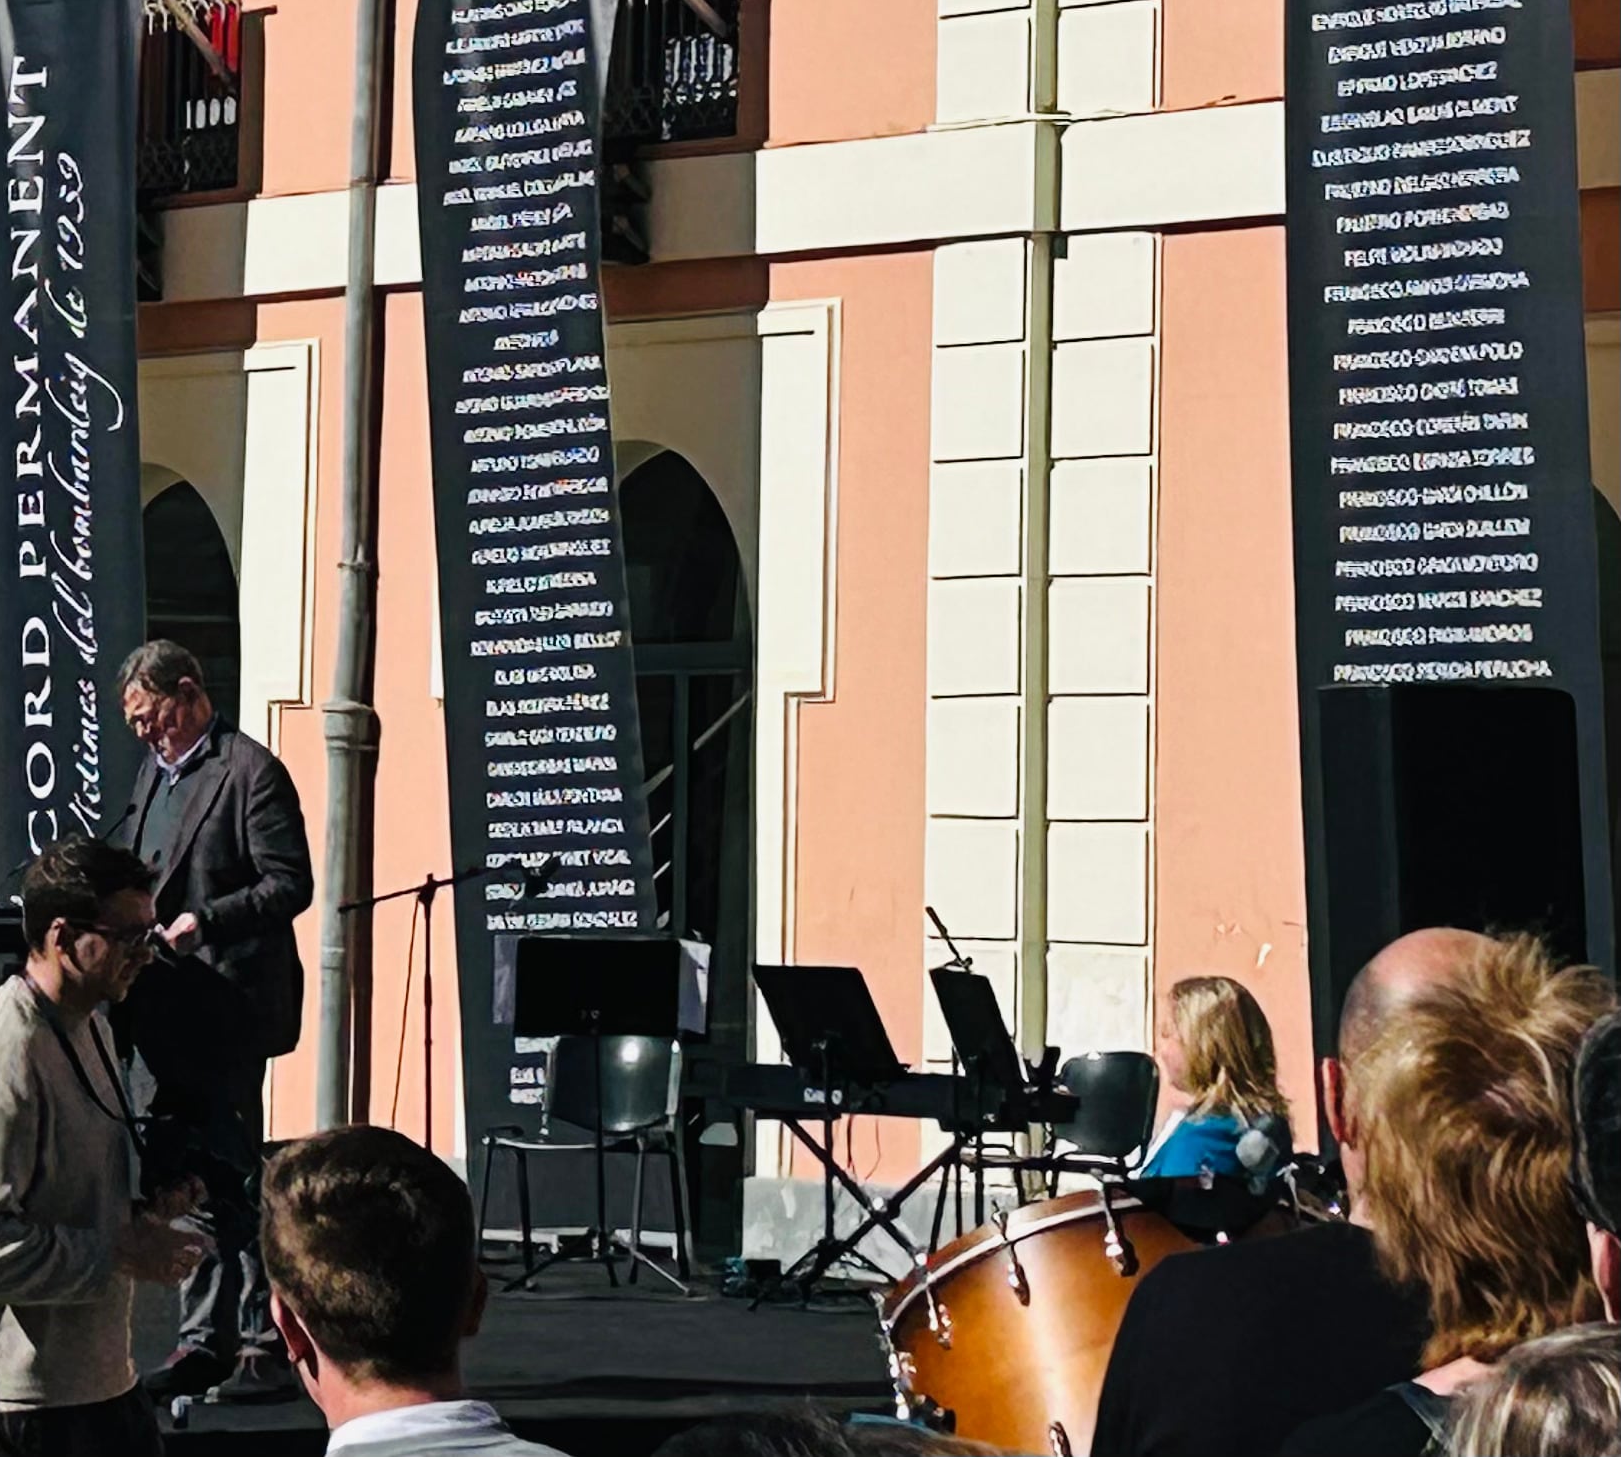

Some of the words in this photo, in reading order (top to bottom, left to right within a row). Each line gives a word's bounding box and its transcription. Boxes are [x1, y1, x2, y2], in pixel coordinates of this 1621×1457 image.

[7, 56, 49, 578] PERMANENT
[44, 278, 88, 338] de
[51, 572, 98, 664] del
